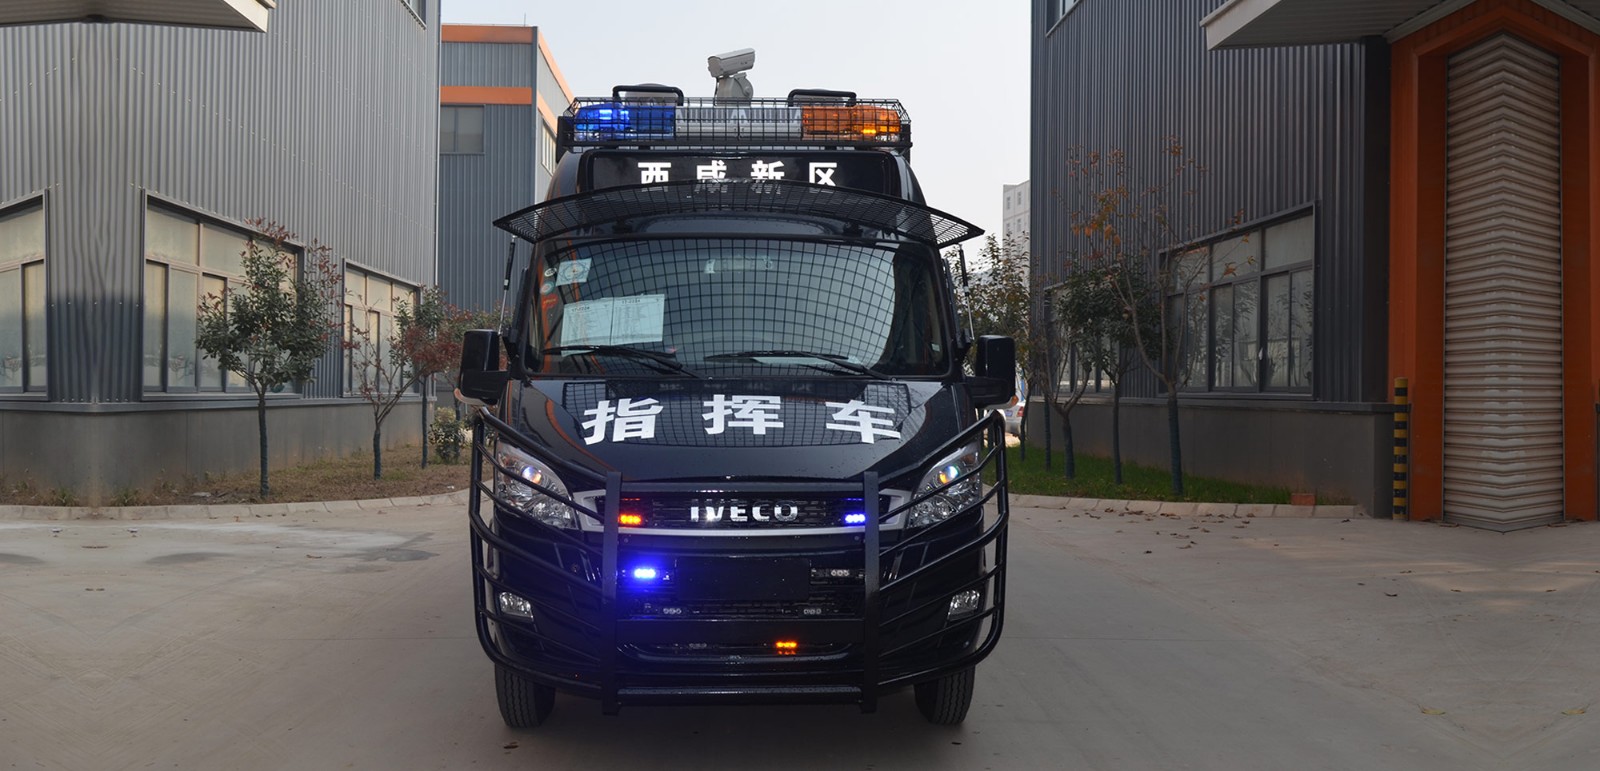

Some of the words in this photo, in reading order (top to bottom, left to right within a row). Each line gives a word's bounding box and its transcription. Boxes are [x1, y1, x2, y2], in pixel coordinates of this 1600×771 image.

[581, 394, 902, 445] 指挥车
[690, 499, 798, 522] IVECO
